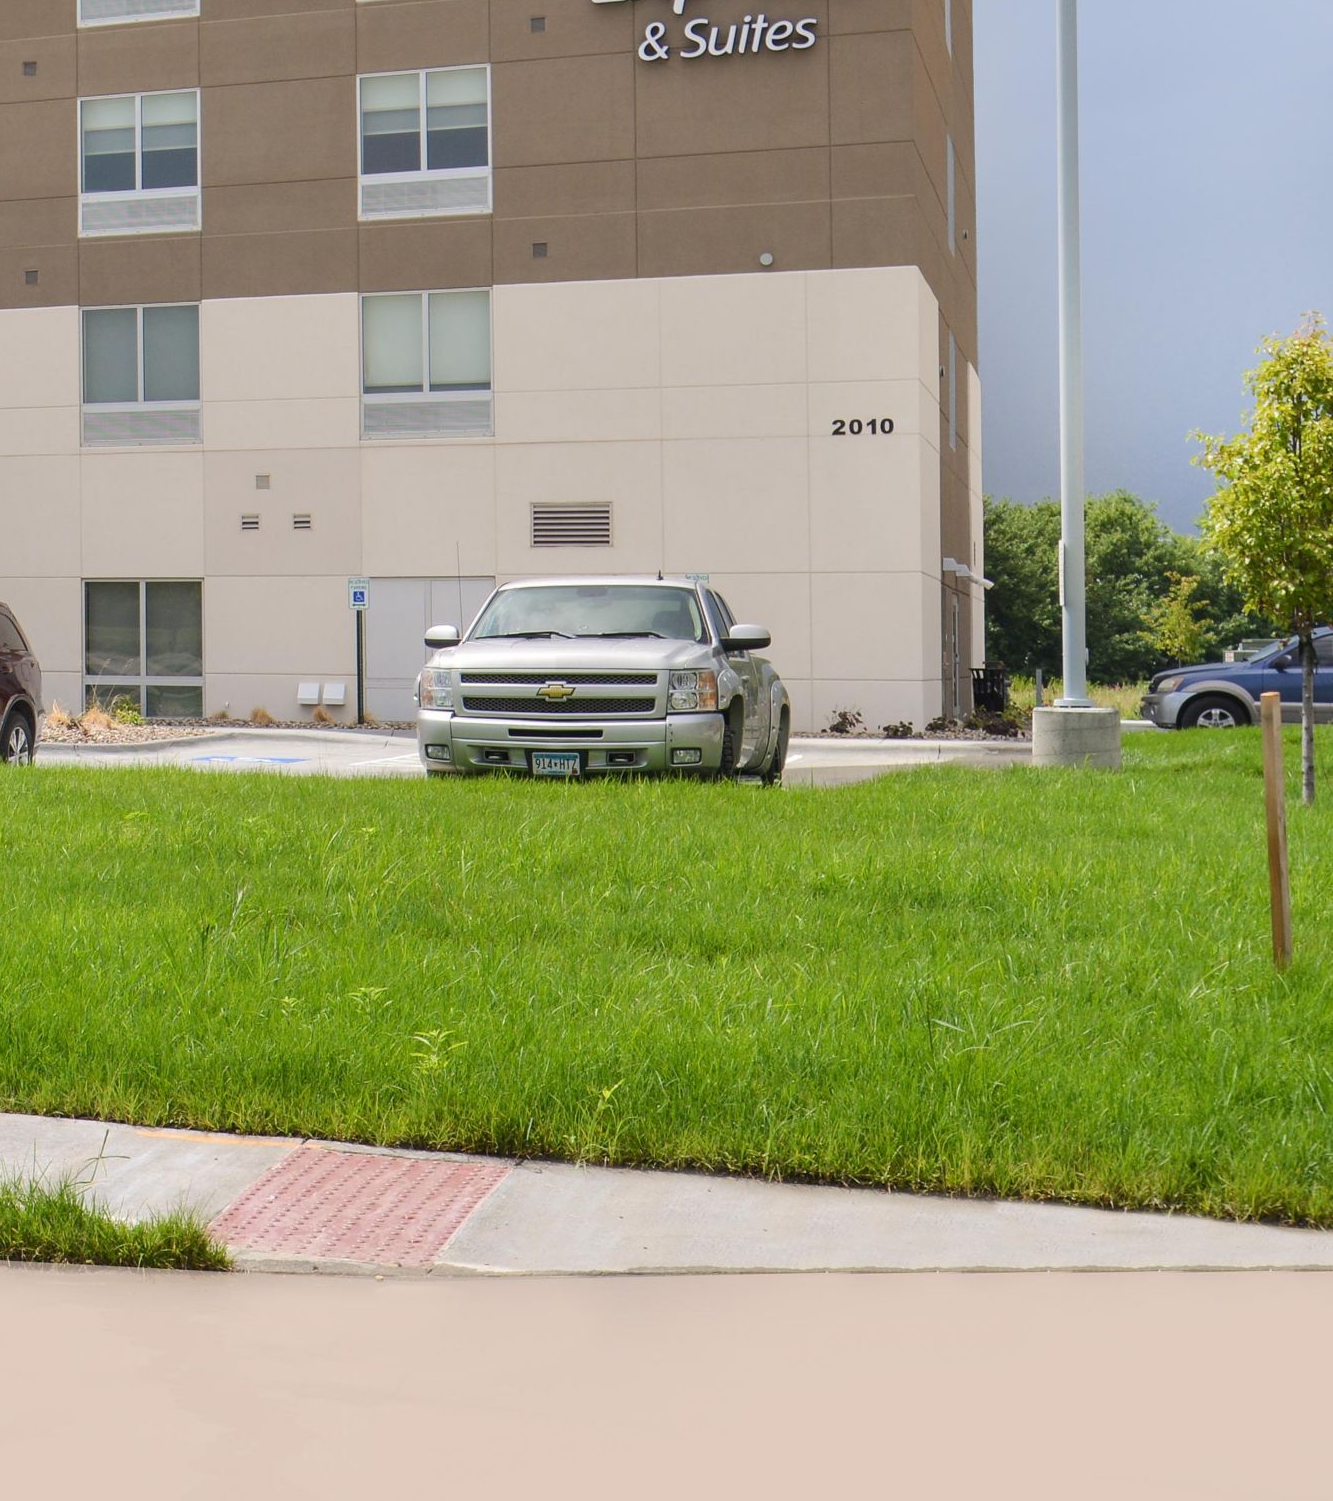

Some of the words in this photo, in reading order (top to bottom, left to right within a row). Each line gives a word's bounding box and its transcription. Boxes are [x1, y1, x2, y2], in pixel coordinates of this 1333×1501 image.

[638, 22, 669, 61] &
[680, 14, 818, 59] Suites
[832, 418, 894, 436] 2010
